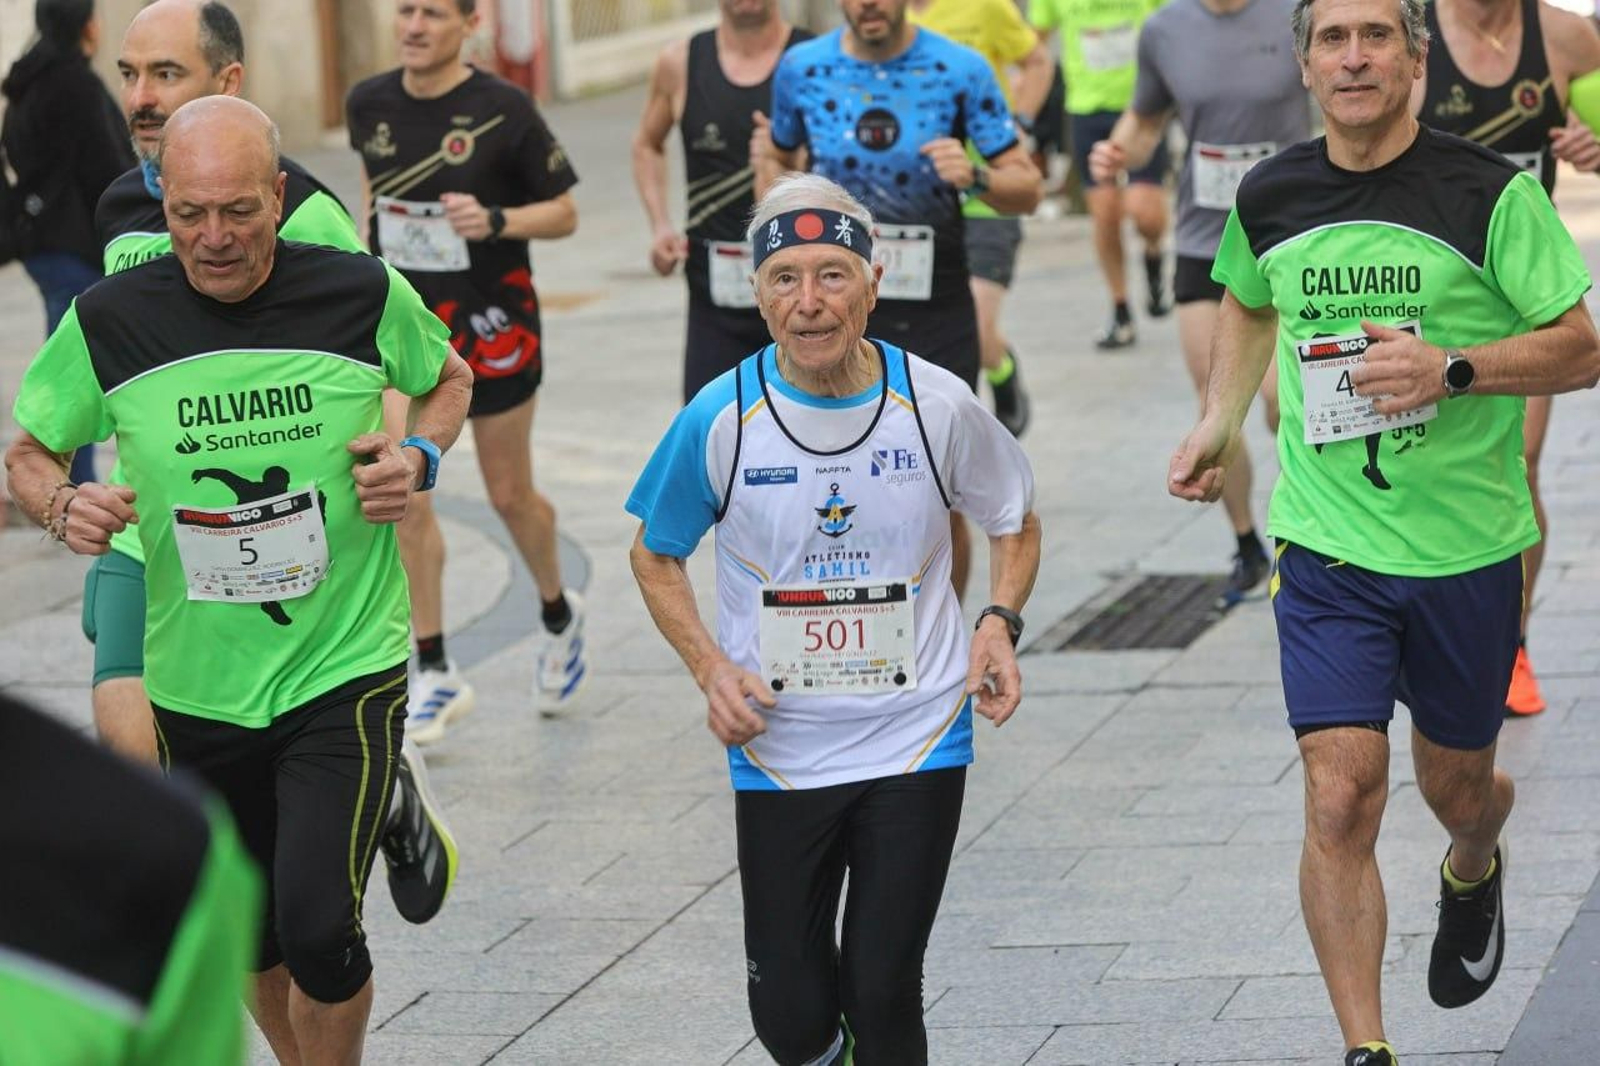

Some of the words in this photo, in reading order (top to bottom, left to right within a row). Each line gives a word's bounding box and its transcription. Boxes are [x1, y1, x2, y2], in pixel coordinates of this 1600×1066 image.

[1302, 265, 1421, 296] CALVARIO
[1325, 302, 1427, 320] Santander
[177, 383, 314, 428] CALVARIO
[205, 422, 324, 452] Santander
[760, 468, 795, 477] HYUNDAI
[886, 471, 927, 486] seguros
[203, 527, 242, 537] CARREIRA
[243, 519, 286, 535] CALVARIO
[239, 537, 258, 565] 5
[804, 551, 871, 564] ATLETISMO
[804, 561, 871, 580] SAMIL
[792, 608, 834, 618] CARREIRA
[836, 606, 878, 616] CALVARIO
[804, 619, 865, 652] 501
